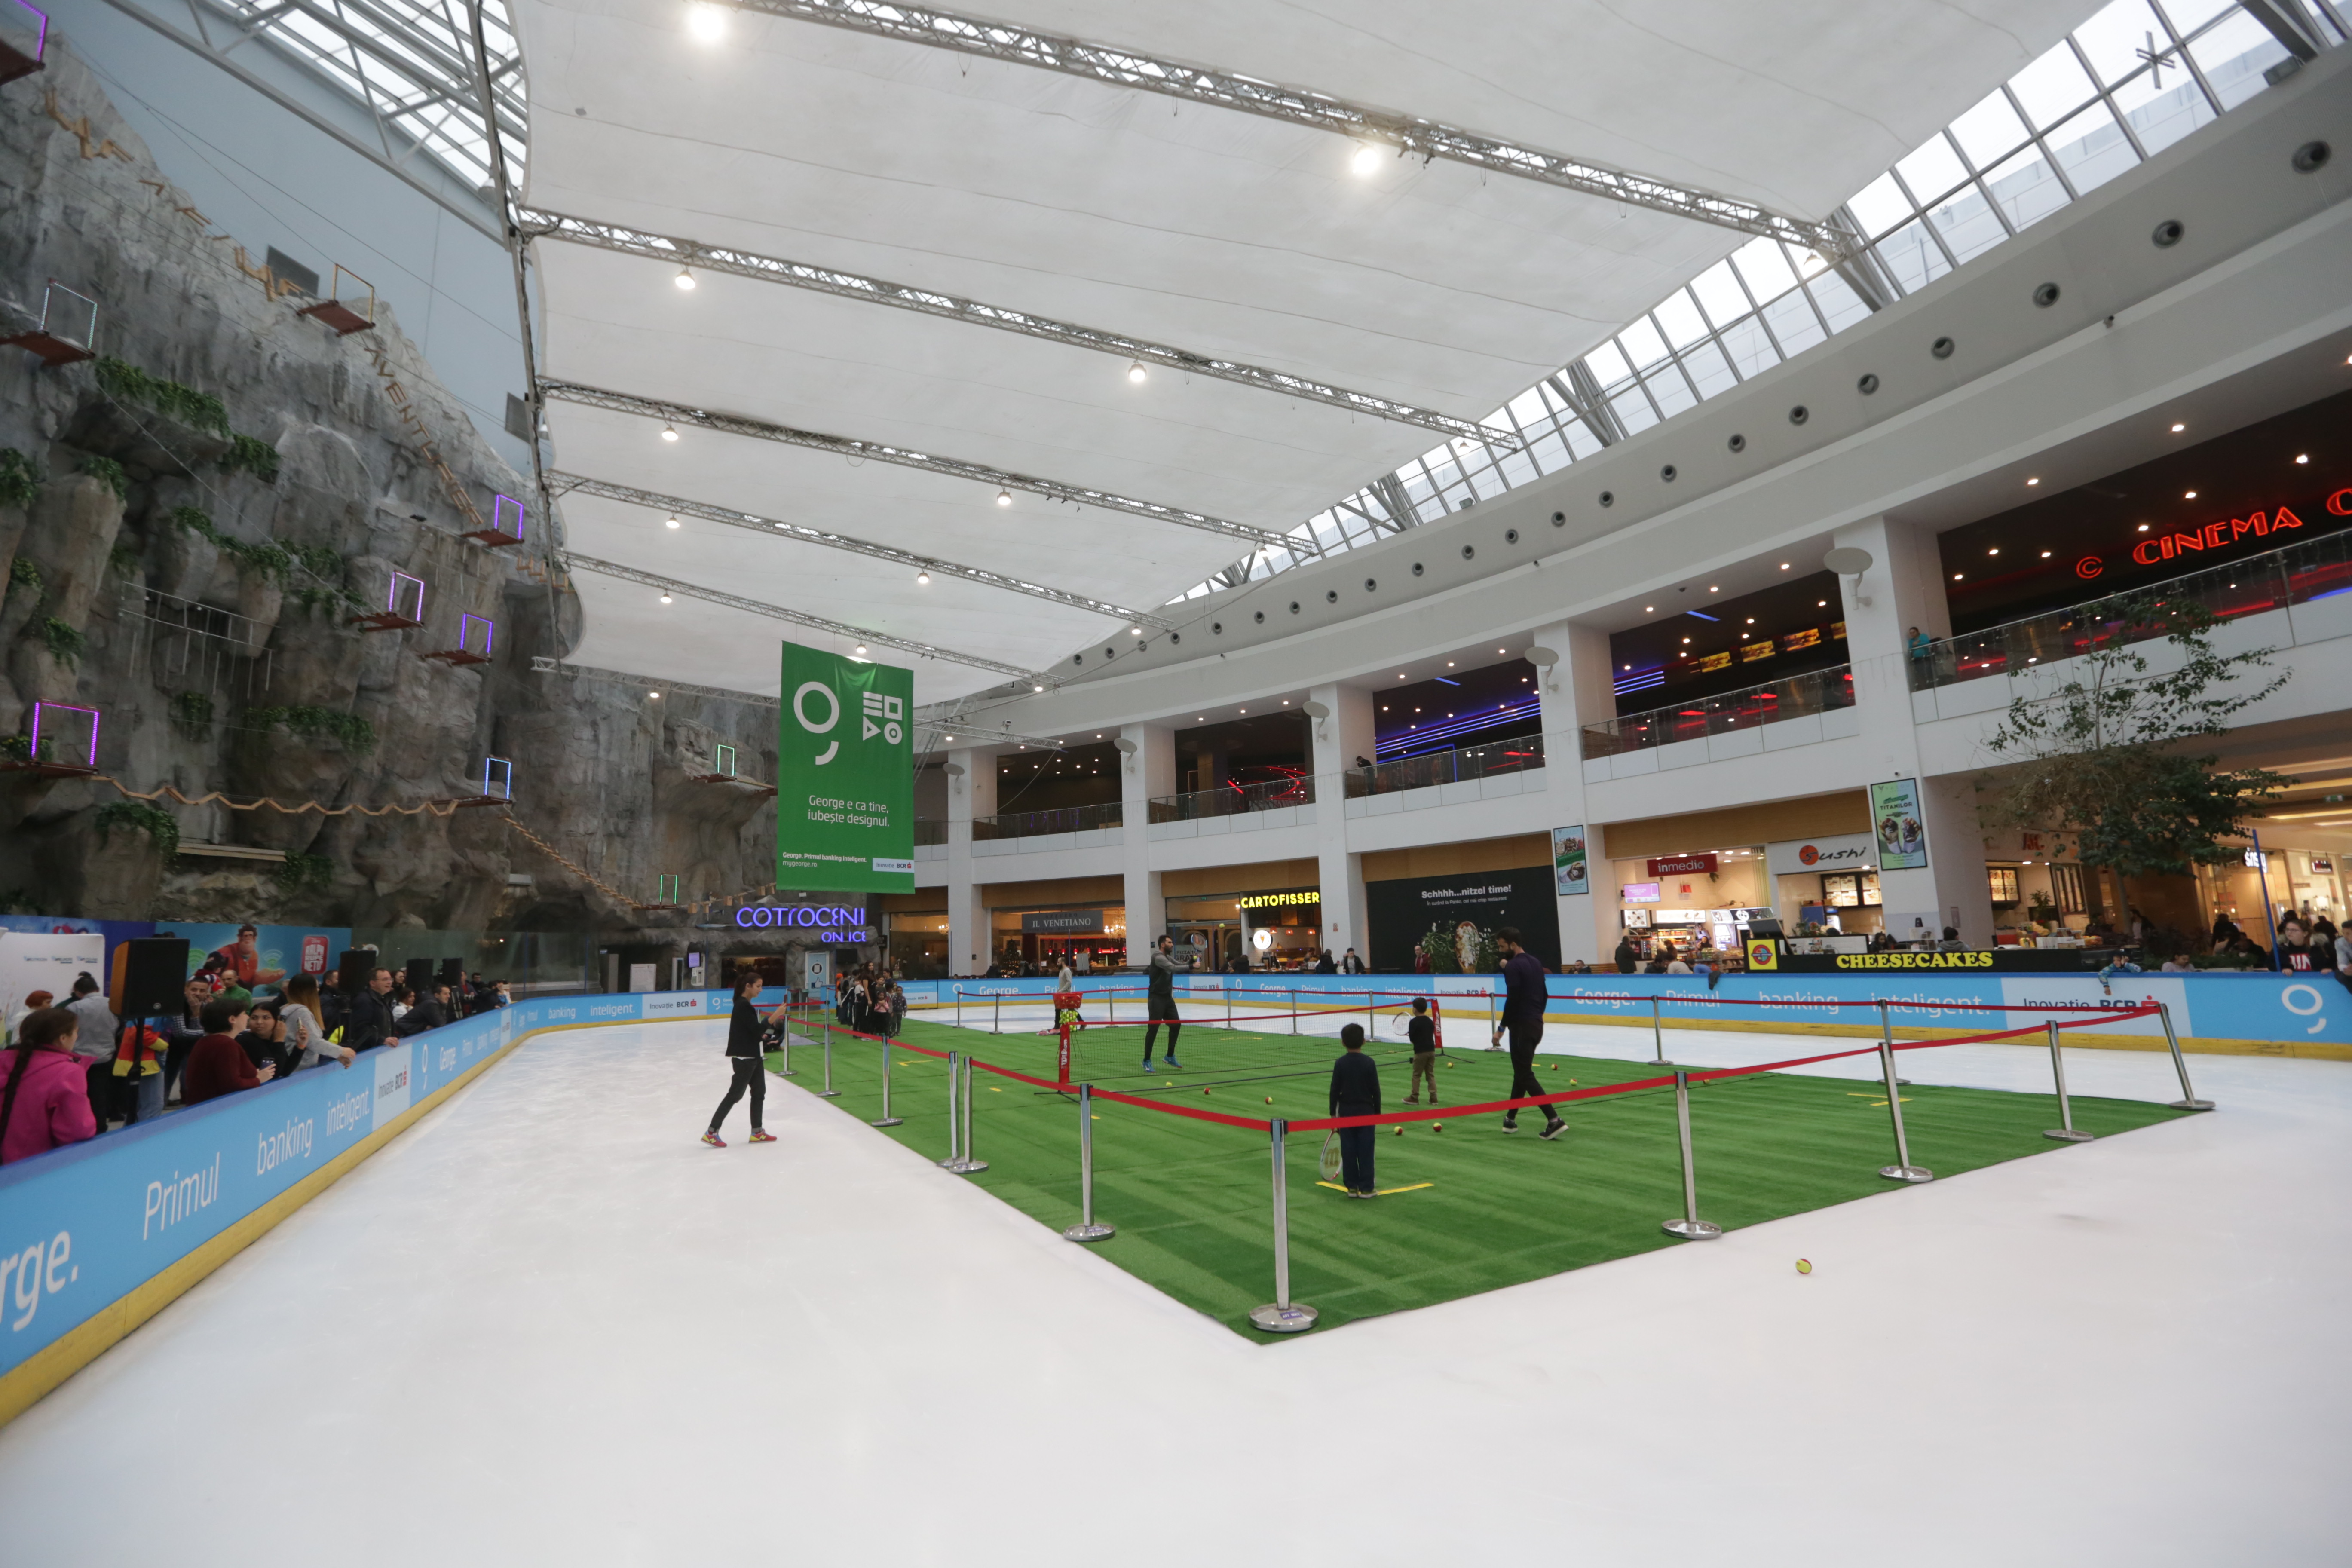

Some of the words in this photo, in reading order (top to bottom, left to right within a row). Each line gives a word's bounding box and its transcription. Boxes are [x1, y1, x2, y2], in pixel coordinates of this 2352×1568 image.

[2133, 506, 2303, 564] CINEMA
[809, 795, 844, 810] George
[847, 801, 853, 809] e
[856, 802, 866, 810] ca
[869, 802, 888, 814] tine,
[1880, 802, 1912, 810] TITANILOR
[808, 809, 844, 824] iubește
[847, 813, 889, 827] designul.
[1658, 860, 1704, 872] inmedio
[1241, 891, 1320, 908] CARTOFISSER
[1421, 886, 1485, 898] Schhhh...nitzel
[1488, 885, 1511, 894] time!
[1044, 918, 1091, 927] VENETIANO
[821, 931, 843, 943] ON
[849, 931, 866, 942] ICE
[1836, 952, 1993, 968] CHEESECAKES
[1574, 988, 1635, 1008] George.
[1666, 990, 1720, 1007] Primul
[1759, 991, 1839, 1014] banking
[1871, 992, 1990, 1018] inteligent.
[548, 1007, 576, 1019] banking
[590, 1004, 635, 1017] inteligent.
[143, 1151, 220, 1240] Primul
[257, 1116, 313, 1176] banking
[327, 1087, 370, 1136] inteligent.
